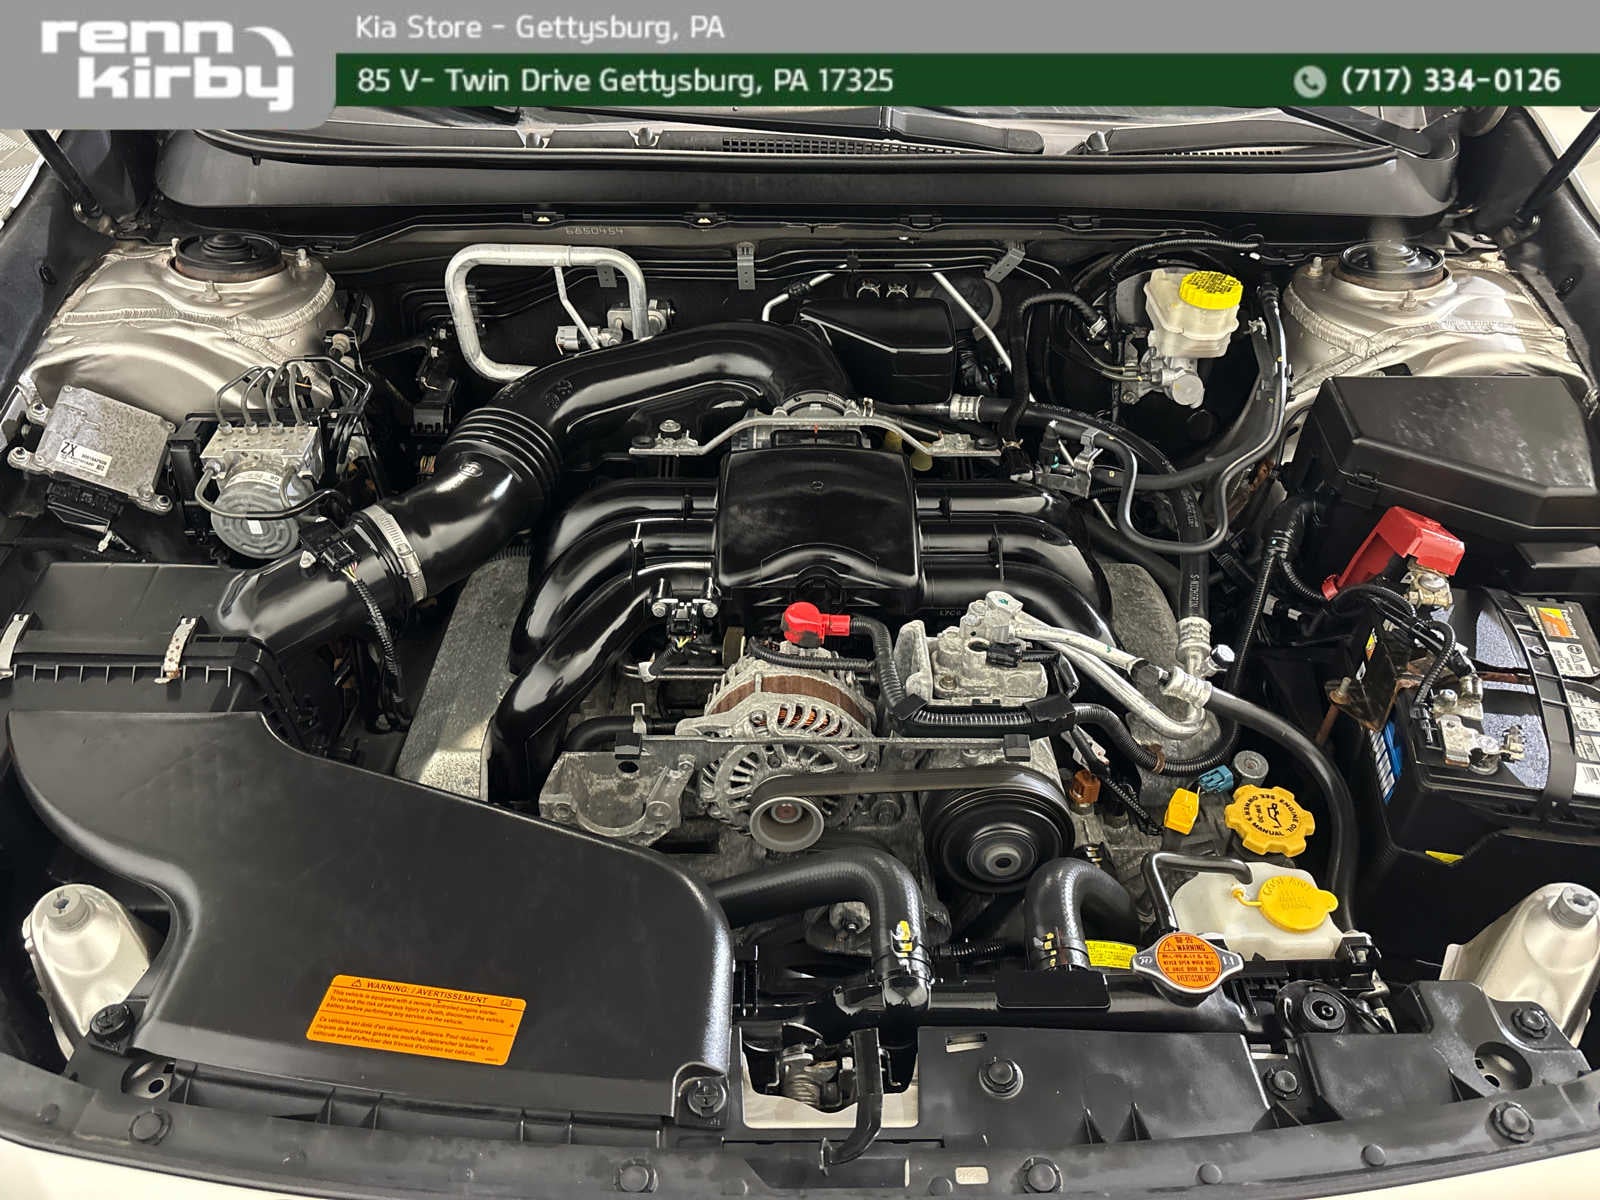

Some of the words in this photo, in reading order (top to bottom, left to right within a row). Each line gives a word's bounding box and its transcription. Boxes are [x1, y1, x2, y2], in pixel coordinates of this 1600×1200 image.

[61, 442, 77, 456] ZX
[1252, 822, 1284, 836] MANUAL
[367, 983, 408, 993] WARNING:
[417, 989, 488, 1003] AVERTISSEMENT
